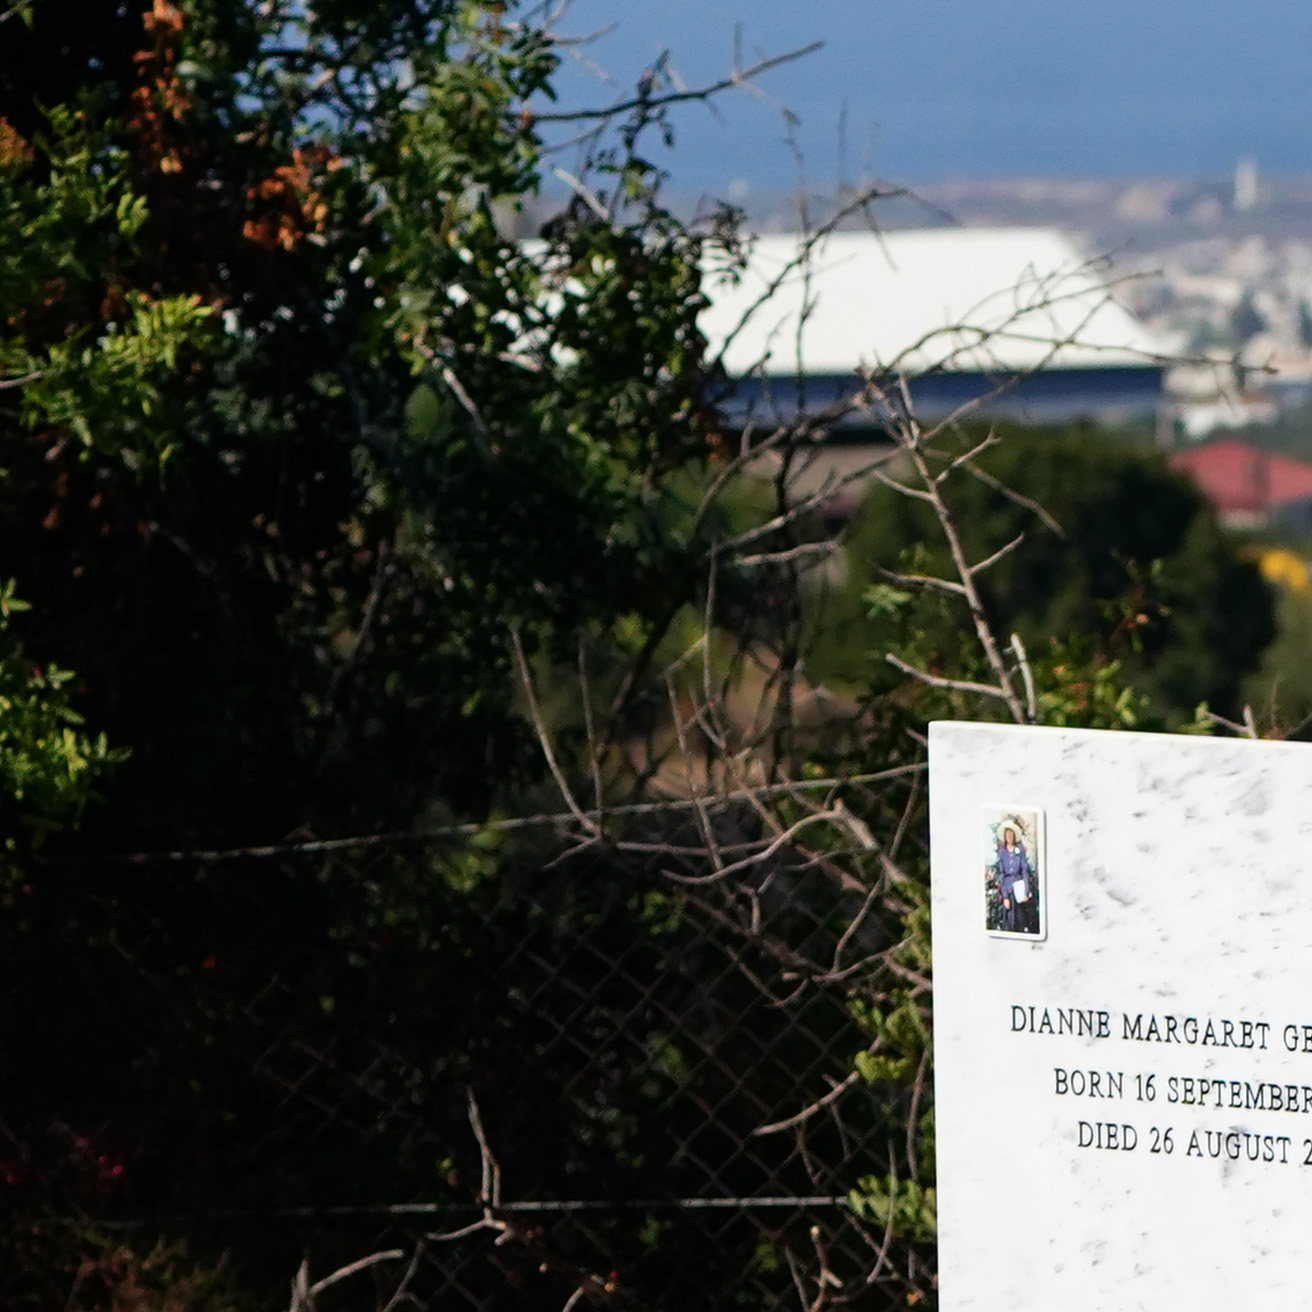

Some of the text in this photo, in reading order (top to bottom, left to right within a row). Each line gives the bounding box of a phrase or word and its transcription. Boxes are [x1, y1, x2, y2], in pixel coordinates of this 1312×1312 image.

[1011, 1005, 1111, 1040] DIANNE
[1121, 1014, 1271, 1052] MARGARET
[1054, 1068, 1123, 1101] BORN
[1135, 1074, 1157, 1102] 16
[1077, 1120, 1139, 1153] DIED
[1149, 1127, 1174, 1156] 26
[1185, 1130, 1292, 1166] AUGUST
